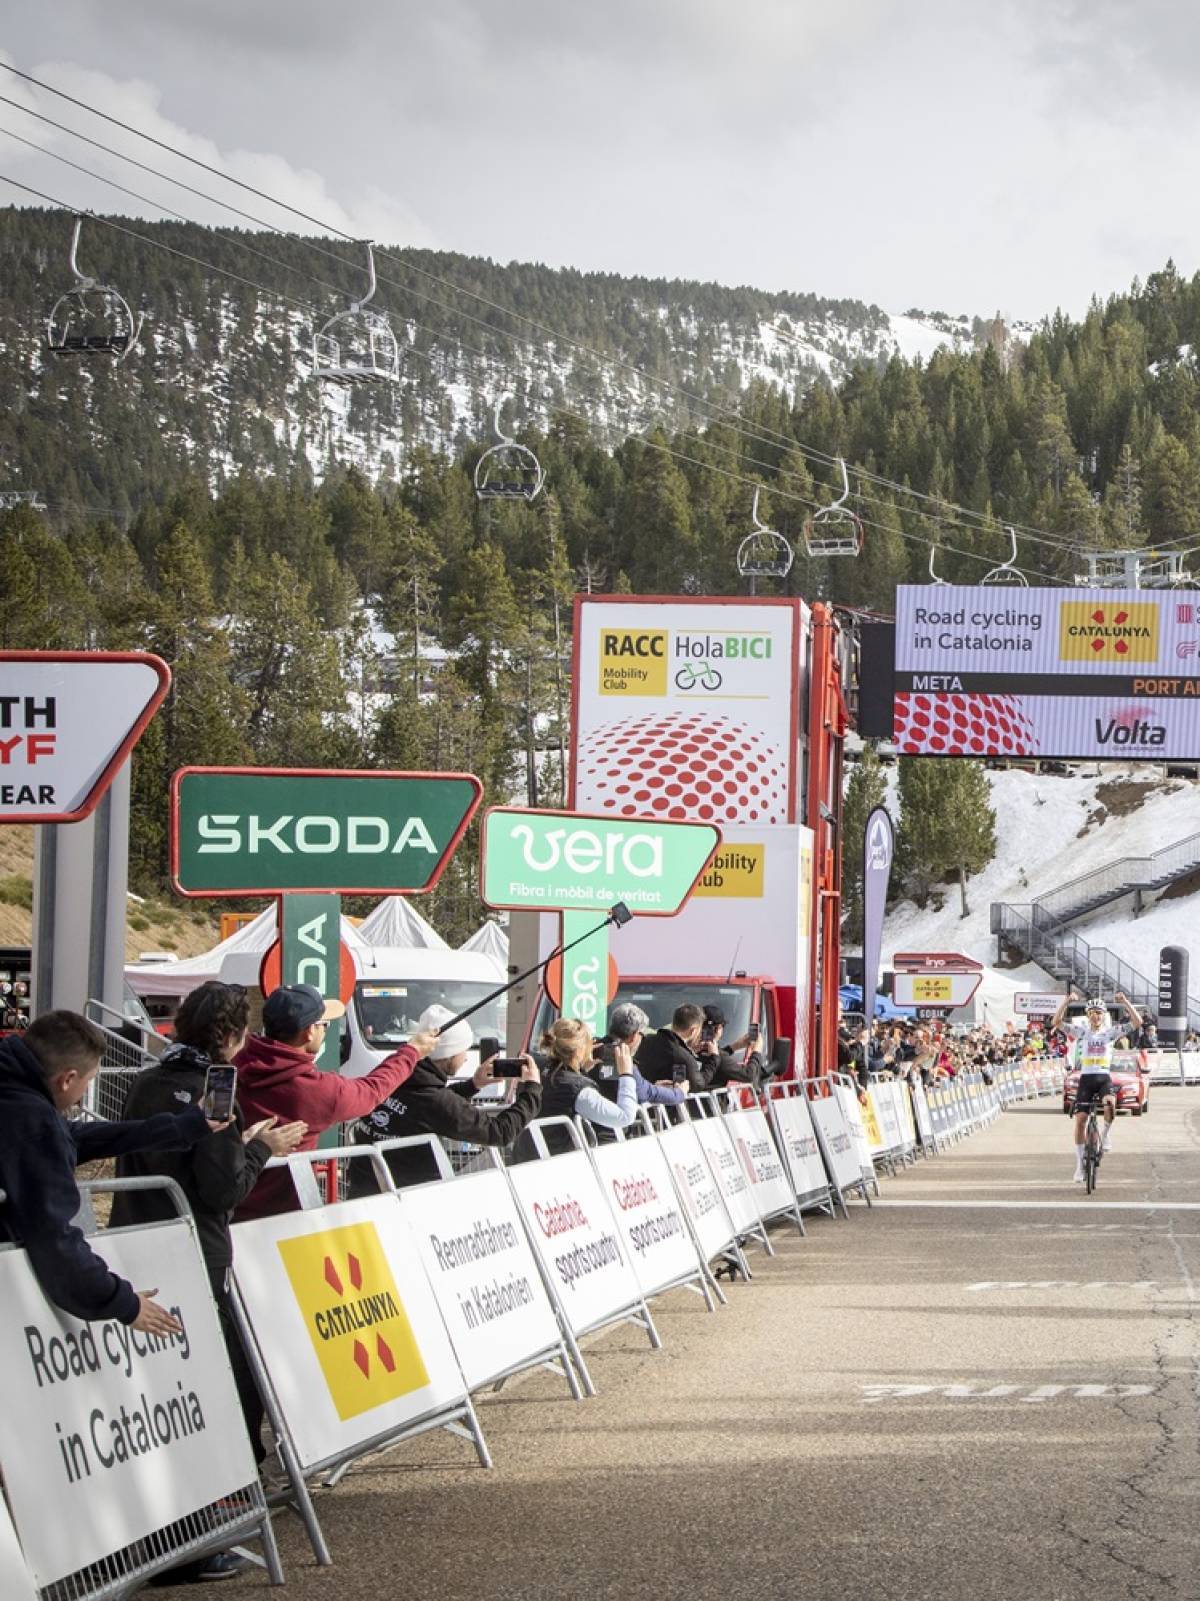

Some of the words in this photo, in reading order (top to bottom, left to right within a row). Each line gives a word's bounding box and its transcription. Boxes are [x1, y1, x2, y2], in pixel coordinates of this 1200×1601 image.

[915, 608, 966, 625] Road
[971, 609, 1042, 631] cycling
[914, 633, 932, 650] in
[938, 633, 1033, 652] Catalonia
[1068, 625, 1151, 638] CATALUNYA
[603, 635, 664, 657] RACC
[675, 635, 772, 659] HolaBICI
[603, 667, 648, 681] Mobility
[603, 679, 627, 690] Club
[912, 675, 963, 691] META
[1133, 679, 1180, 695] PORT
[1095, 718, 1167, 745] Volta
[510, 824, 663, 877] vera
[709, 853, 756, 874] bility
[510, 883, 544, 897] Fibra
[548, 885, 553, 897] i
[555, 884, 594, 899] mòbil
[596, 886, 613, 900] de
[617, 889, 661, 904] veritat
[430, 1218, 519, 1272] Rennradfahren
[456, 1291, 480, 1330] in
[473, 1272, 535, 1324] Katalonien
[314, 1291, 400, 1342] CATALUNYA
[23, 1319, 102, 1388] Road
[55, 1422, 91, 1484] in
[90, 1380, 206, 1469] Catalonia
